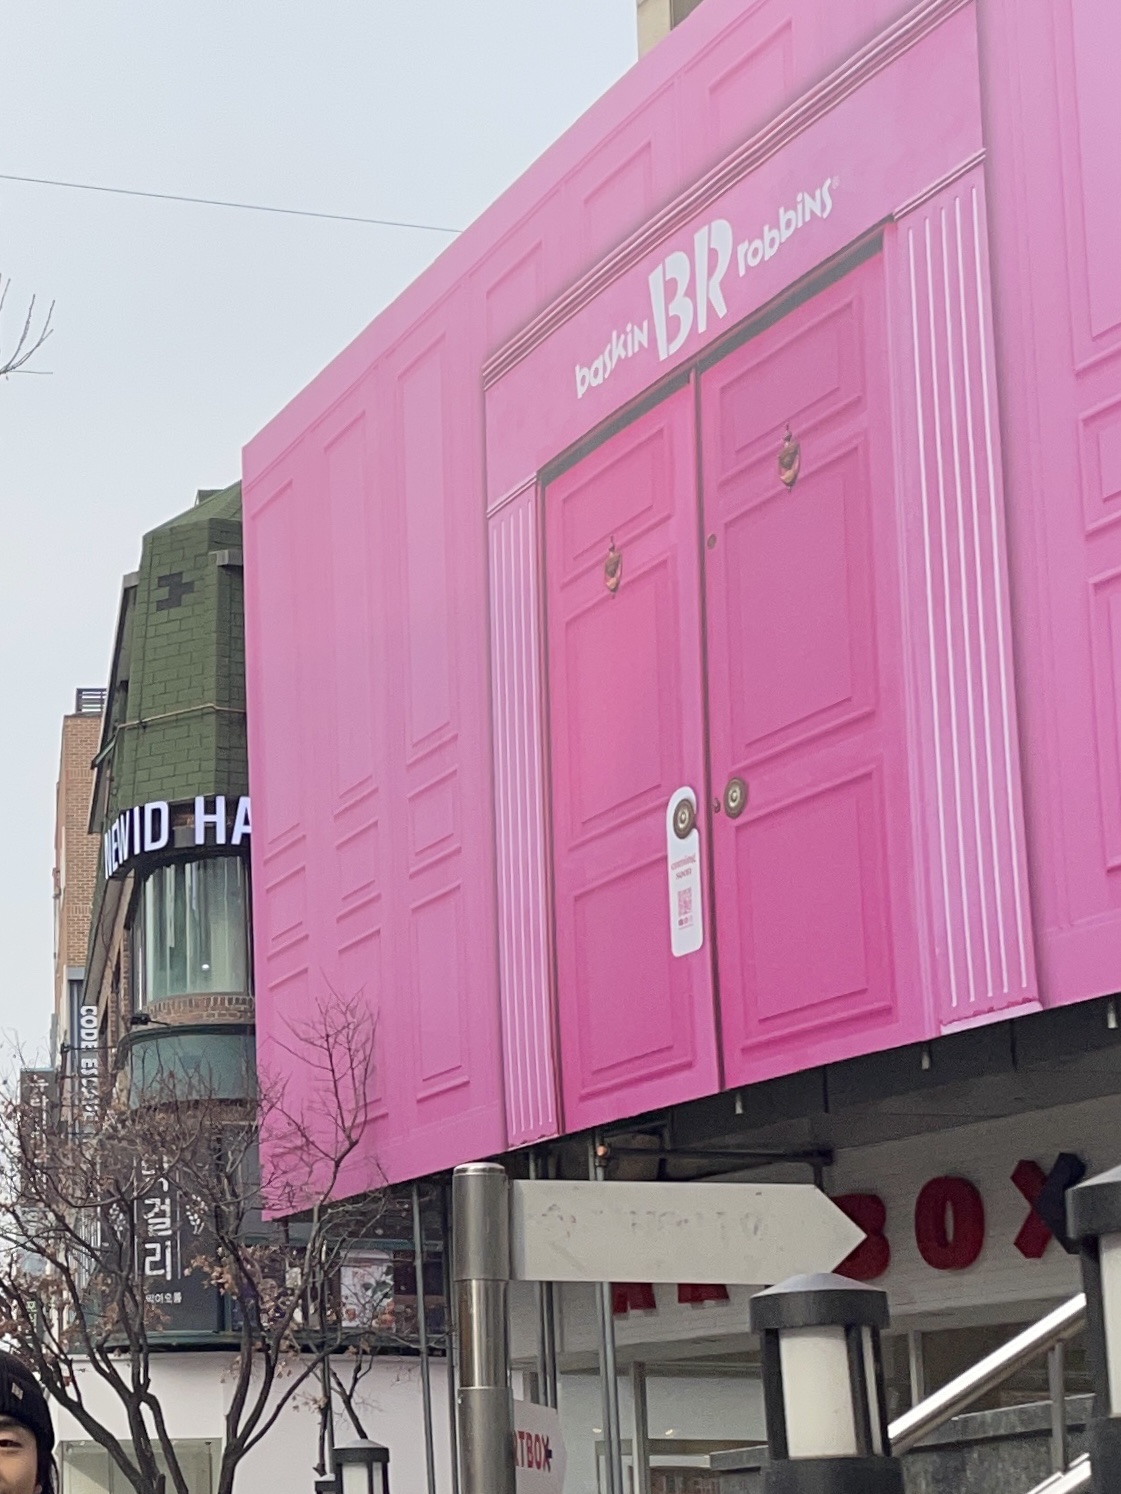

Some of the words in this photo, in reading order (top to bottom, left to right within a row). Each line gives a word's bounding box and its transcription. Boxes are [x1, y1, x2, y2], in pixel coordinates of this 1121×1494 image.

[574, 320, 648, 399] baskin
[648, 218, 733, 361] BR
[736, 177, 833, 277] robbins
[80, 1005, 98, 1051] CODE
